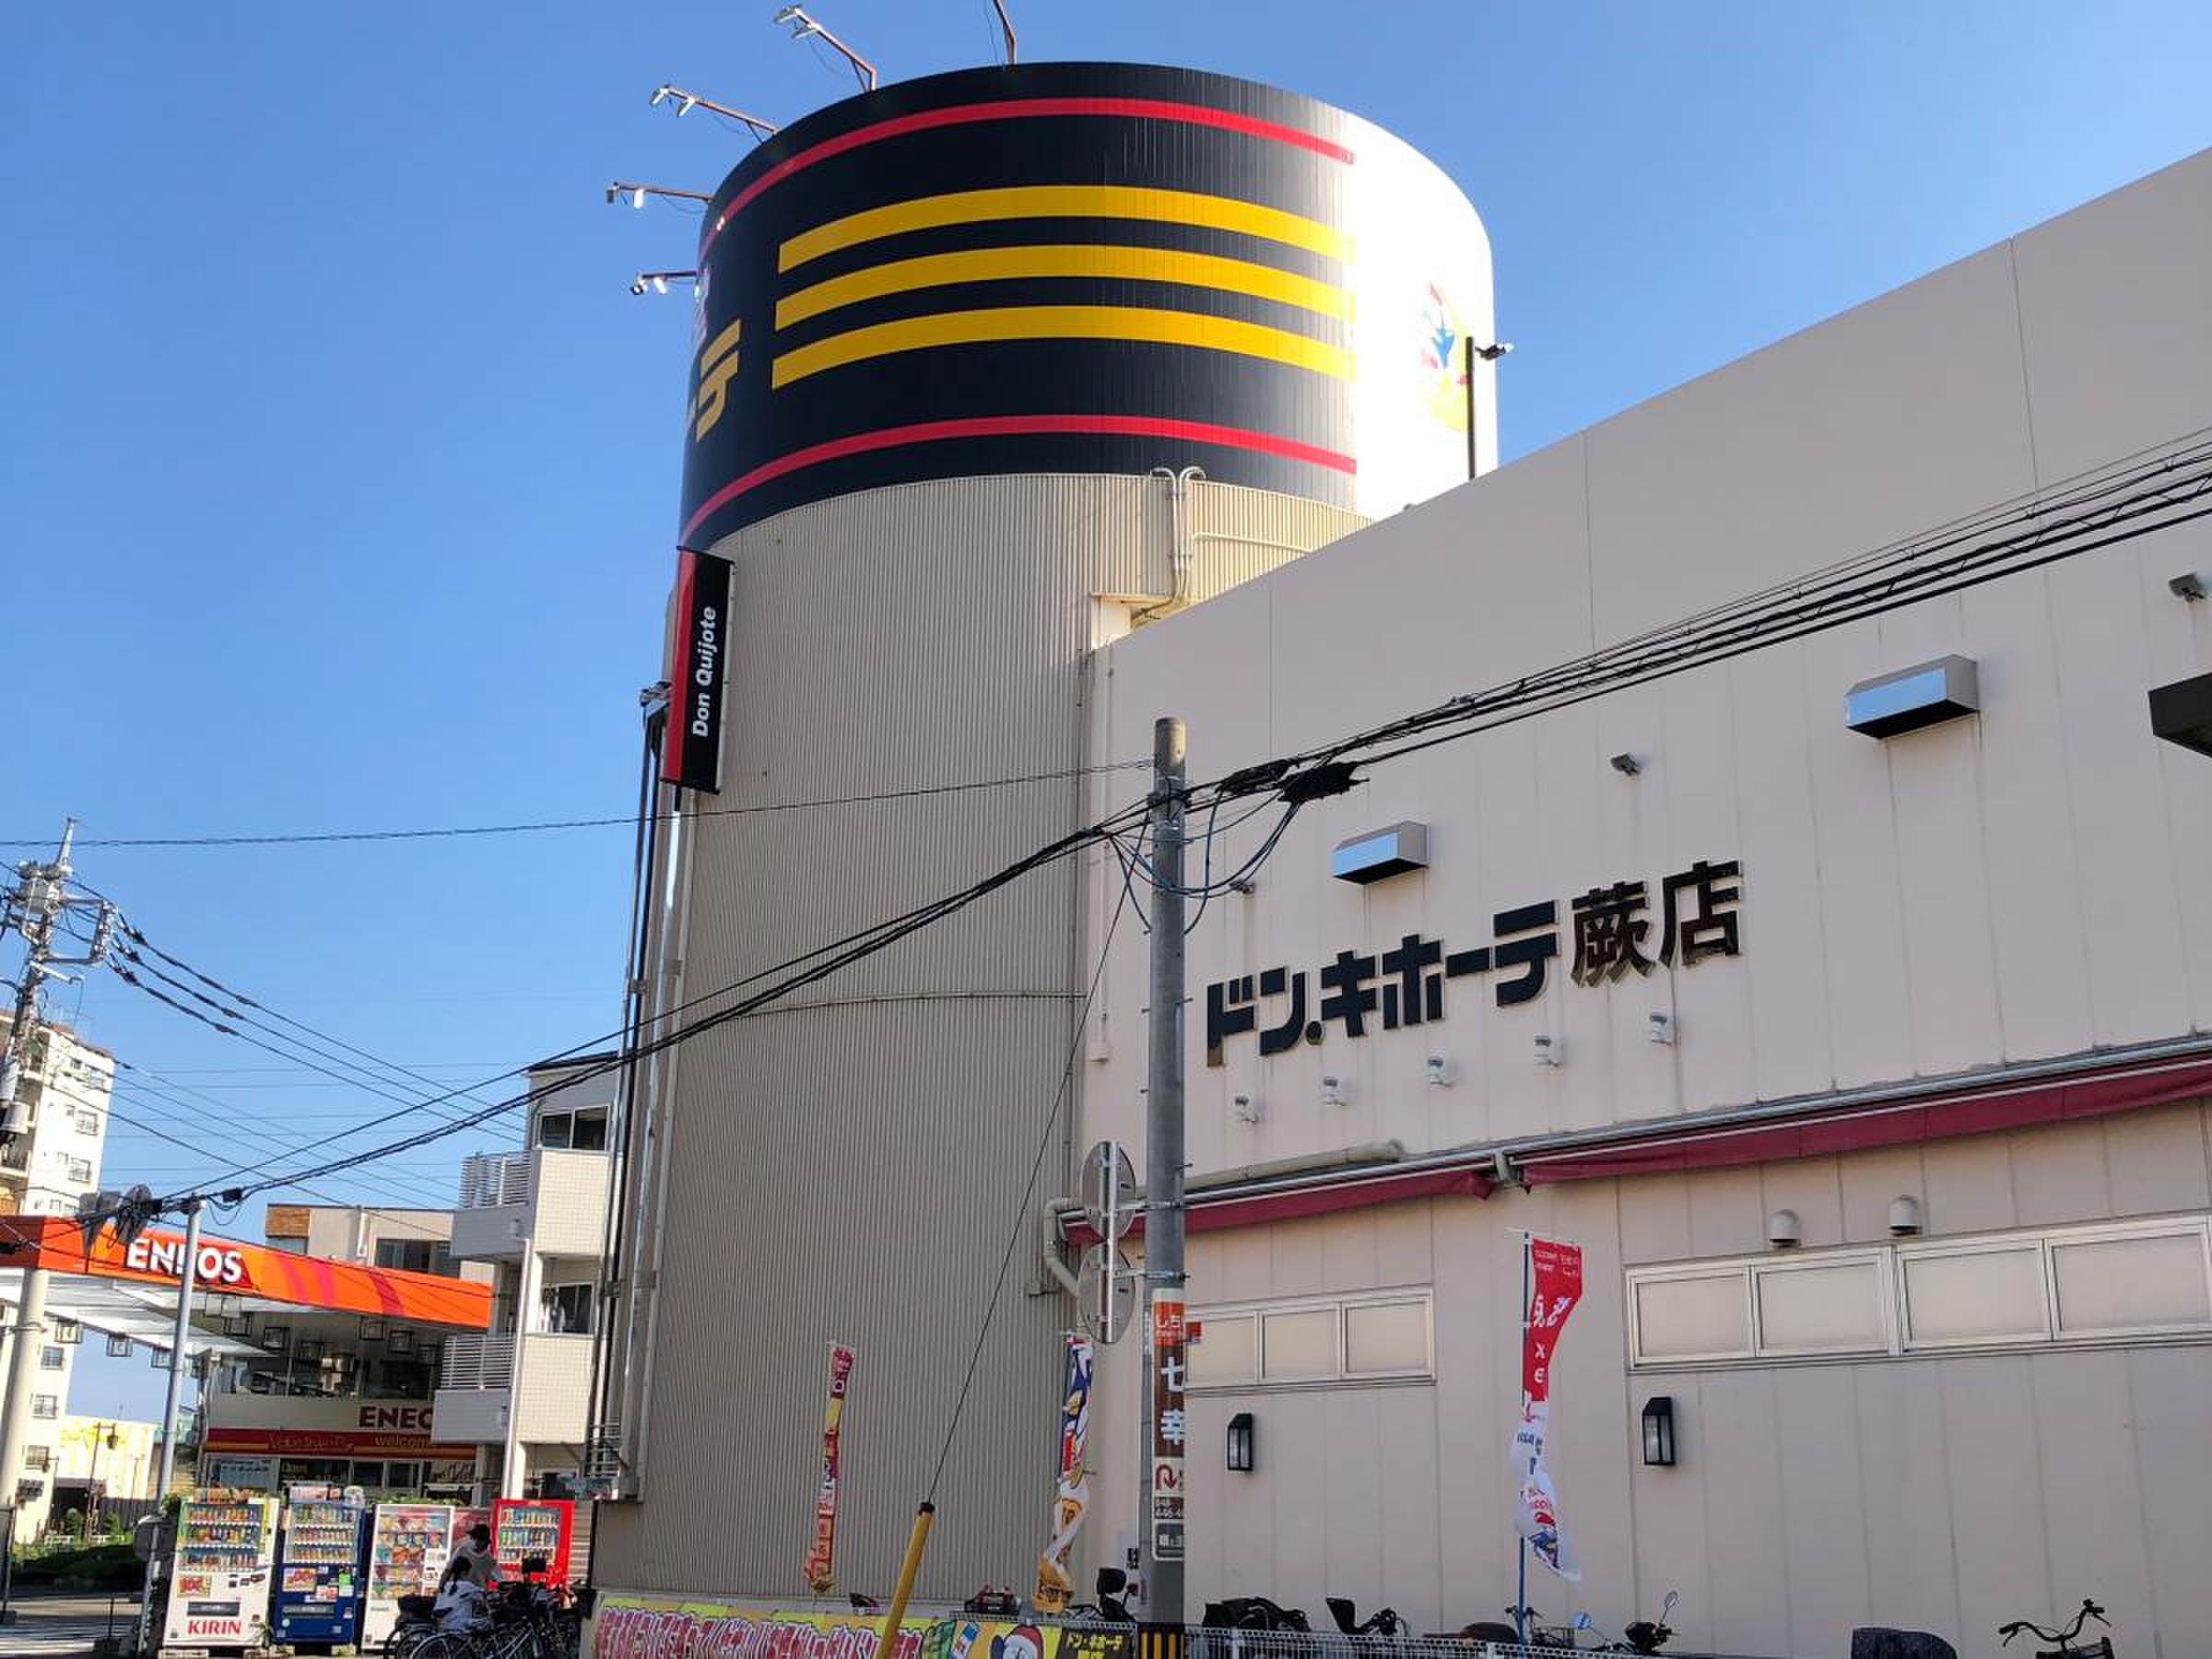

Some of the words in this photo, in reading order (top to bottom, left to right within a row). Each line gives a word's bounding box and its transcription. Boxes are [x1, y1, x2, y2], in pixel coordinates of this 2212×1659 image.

[695, 606, 718, 687] Quijote
[692, 692, 711, 737] Don
[359, 1406, 433, 1430] ENEO
[187, 1619, 242, 1635] KIRIN
